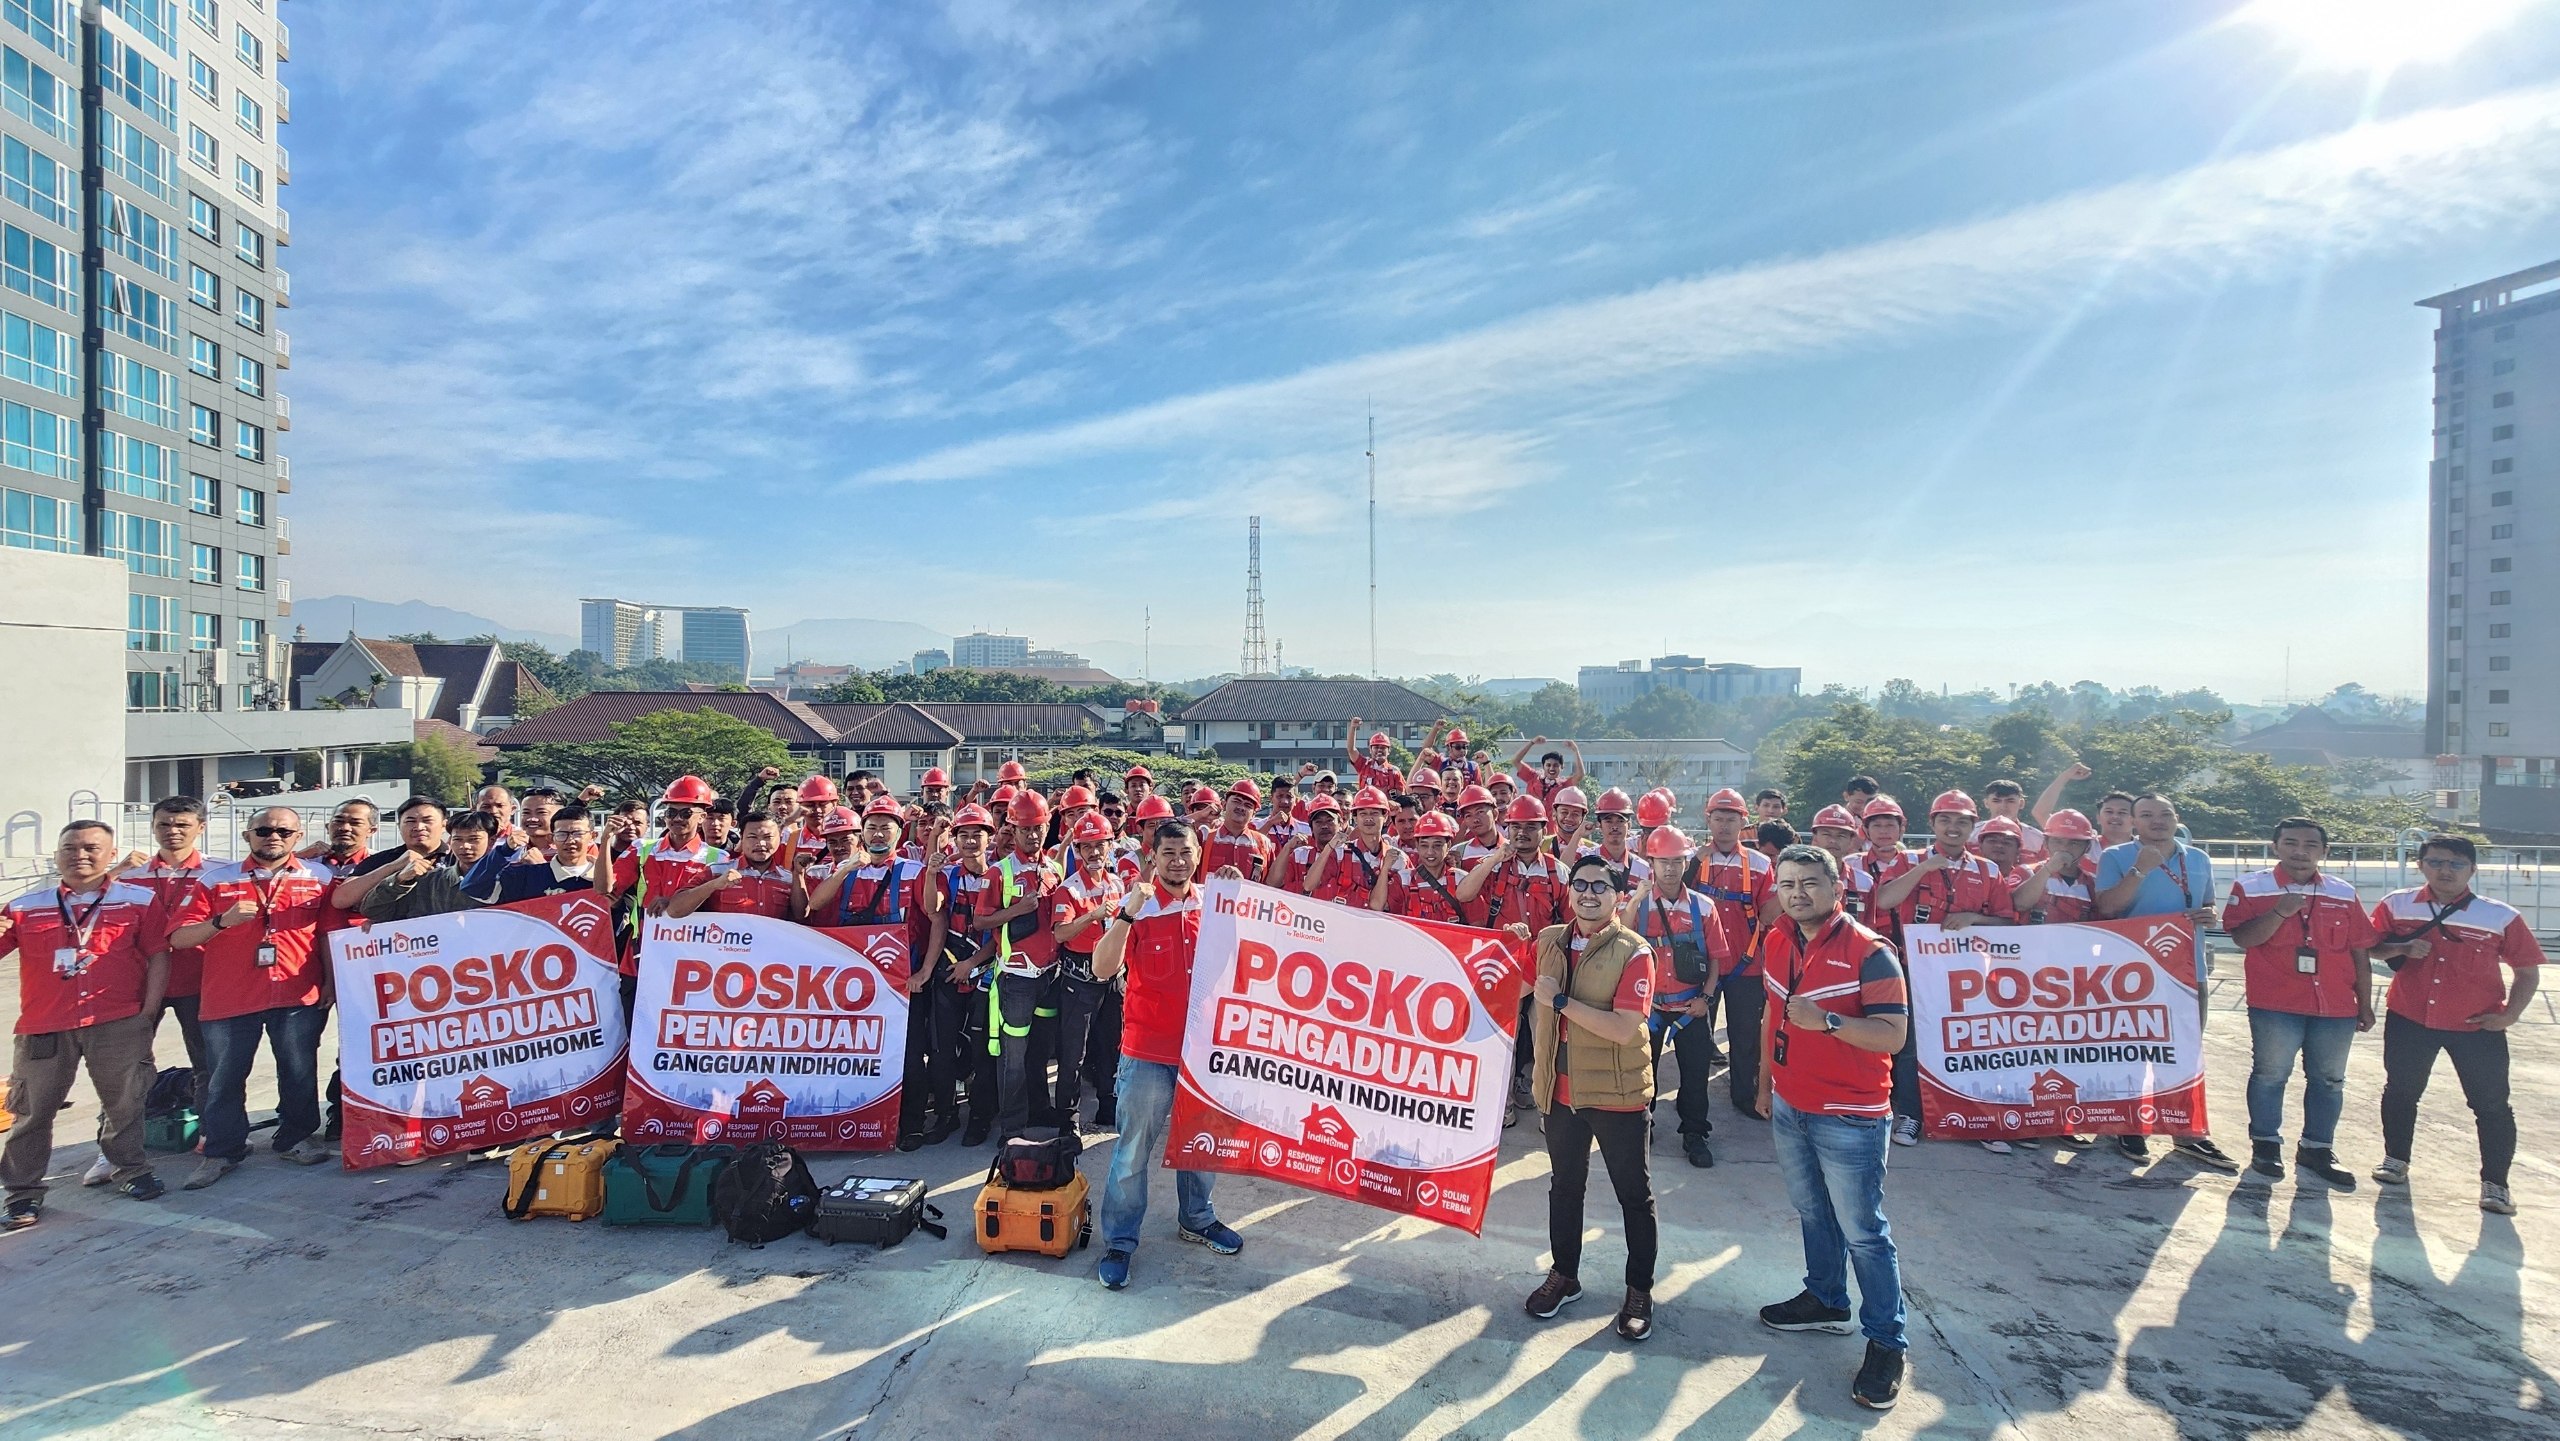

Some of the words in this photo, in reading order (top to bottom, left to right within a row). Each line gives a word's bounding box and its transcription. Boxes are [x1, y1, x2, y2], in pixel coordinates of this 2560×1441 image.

[1215, 892, 1325, 933] IndiHome
[653, 923, 753, 945] IndiHome
[1292, 930, 1325, 944] Telkomsel
[345, 932, 439, 960] IndiHome
[1917, 936, 2021, 954] IndiHome
[374, 943, 577, 1019] POSKO
[670, 959, 876, 1012] POSKO
[1948, 961, 2155, 1013] POSKO
[1233, 939, 1471, 1044] POSKO
[378, 993, 595, 1059] PENGADUAN
[664, 1014, 880, 1050] PENGADUAN
[1949, 1009, 2165, 1049] PENGADUAN
[372, 1052, 488, 1087] GANGGUAN
[492, 1028, 604, 1067] INDIHOME
[1218, 1004, 1475, 1098] PENGADUAN
[653, 1052, 777, 1074] GANGGUAN
[780, 1056, 882, 1077] INDIHOME
[1944, 1048, 2061, 1073] GANGGUAN
[2064, 1045, 2177, 1065] INDIHOME
[593, 1090, 617, 1102] SOLUSI
[1208, 1051, 1344, 1101] GANGGUAN
[1348, 1083, 1476, 1131] INDIHOME
[2036, 1092, 2073, 1101] IndiHome
[464, 1098, 504, 1112] IndiHome
[742, 1105, 781, 1114] IndiHome
[2087, 1108, 2116, 1116] STANDBY
[520, 1107, 549, 1119] STANDBY
[521, 1116, 542, 1126] UNTUK
[542, 1113, 560, 1123] ANDA
[2087, 1115, 2108, 1123] UNTUK
[453, 1120, 487, 1132] RESPONSIF
[665, 1122, 693, 1130] LAYANAN
[665, 1129, 686, 1137] CEPAT
[727, 1123, 760, 1131] RESPONSIF
[859, 1122, 881, 1130] SOLUSI
[395, 1131, 421, 1142] LAYANAN
[454, 1131, 461, 1139] &
[461, 1128, 486, 1138] SOLUTIF
[732, 1131, 757, 1139] SOLUTIF
[859, 1130, 883, 1138] TERBAIK
[395, 1140, 416, 1150] CEPAT
[1218, 1137, 1250, 1149] LAYANAN
[1306, 1130, 1350, 1152] IndiHome
[1216, 1148, 1240, 1159] CEPAT
[1287, 1149, 1326, 1165] RESPONSIF
[1286, 1158, 1292, 1168] &
[1292, 1160, 1322, 1175] SOLUTIF
[1360, 1168, 1393, 1184] STANDBY
[1359, 1178, 1382, 1193] UNTUK
[1382, 1184, 1402, 1197] ANDA
[1442, 1189, 1470, 1203] SOLUSI
[1441, 1200, 1472, 1215] TERBAIK
